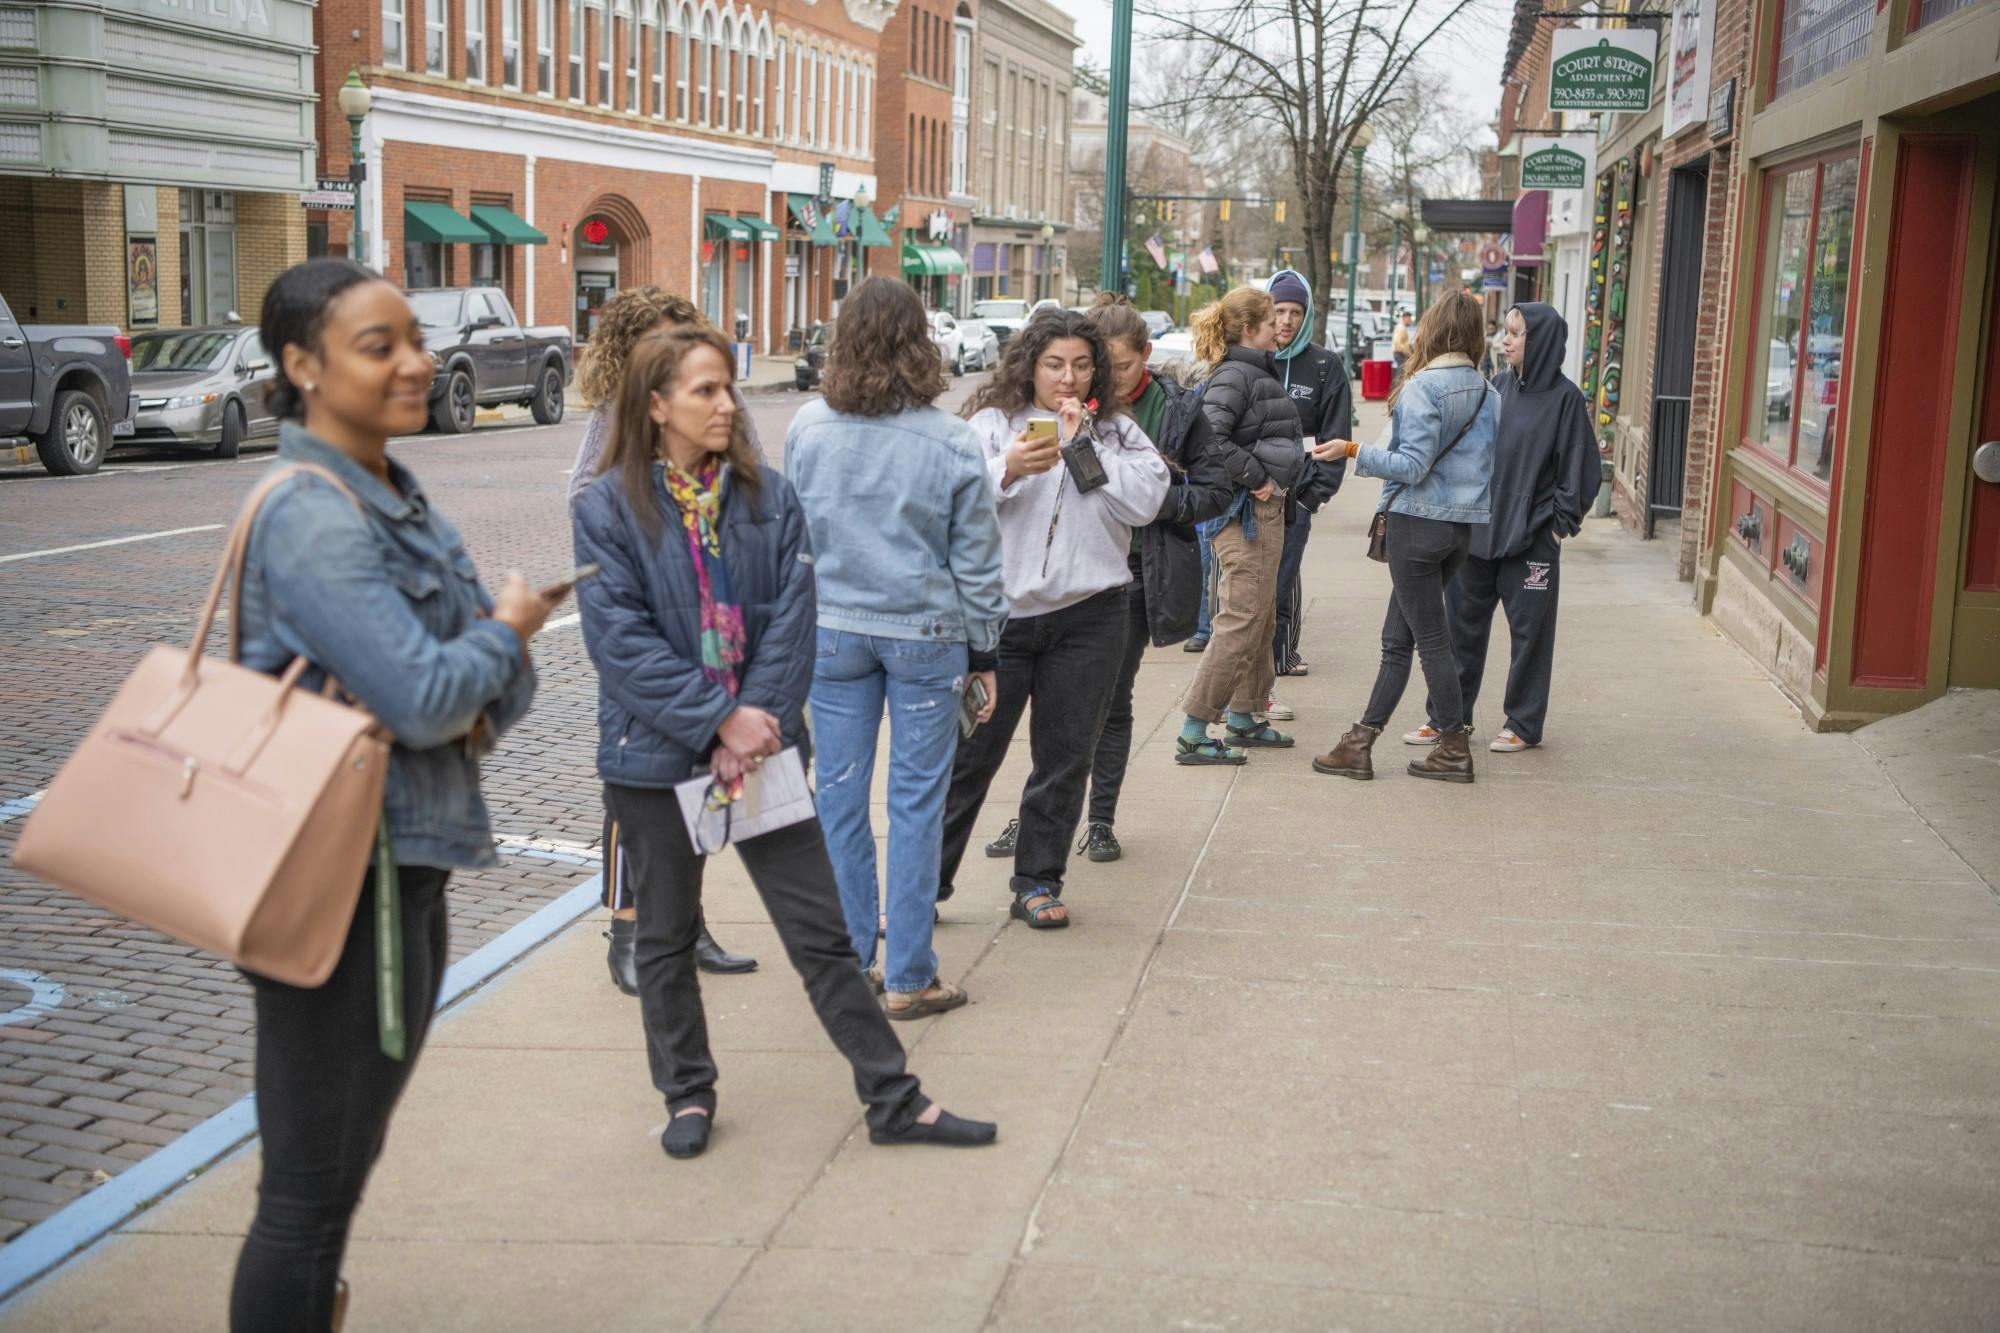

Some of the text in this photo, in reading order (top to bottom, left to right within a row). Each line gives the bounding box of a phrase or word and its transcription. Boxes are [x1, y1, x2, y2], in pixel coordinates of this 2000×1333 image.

[1556, 55, 1647, 78] COURT STREET
[1569, 74, 1633, 82] APARTMENTS
